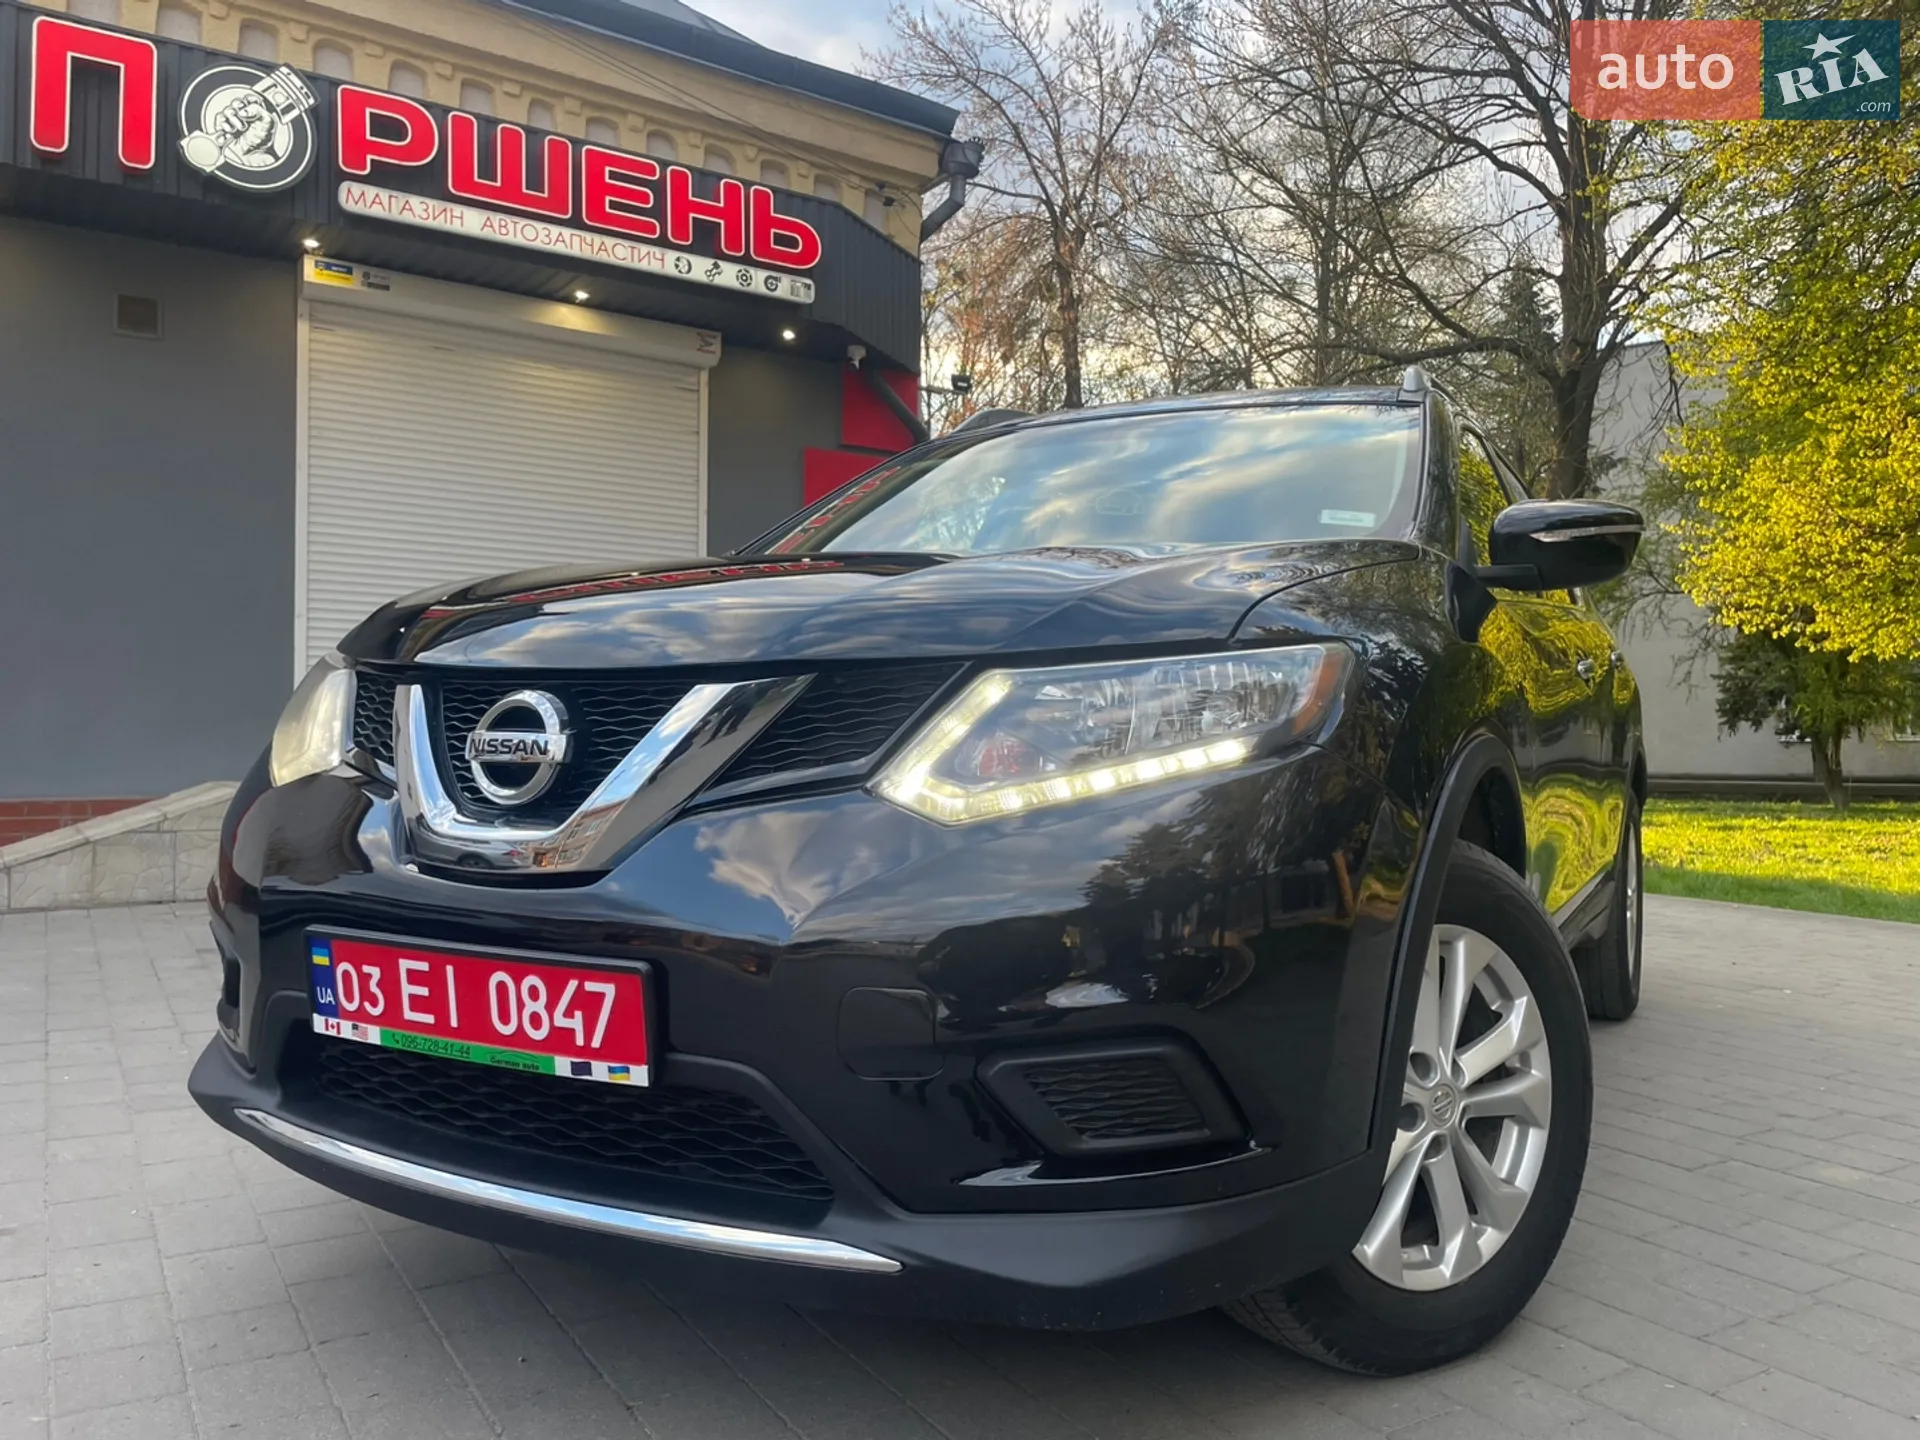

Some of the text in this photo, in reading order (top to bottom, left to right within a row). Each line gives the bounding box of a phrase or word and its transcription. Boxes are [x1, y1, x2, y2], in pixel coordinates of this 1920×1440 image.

[345, 187, 666, 270] МАГАЗИН АВТОЗАПЧАСТИЧ
[469, 738, 548, 756] NISSAN
[317, 986, 336, 1006] UA
[335, 962, 385, 1016] 03
[488, 971, 616, 1049] 0847
